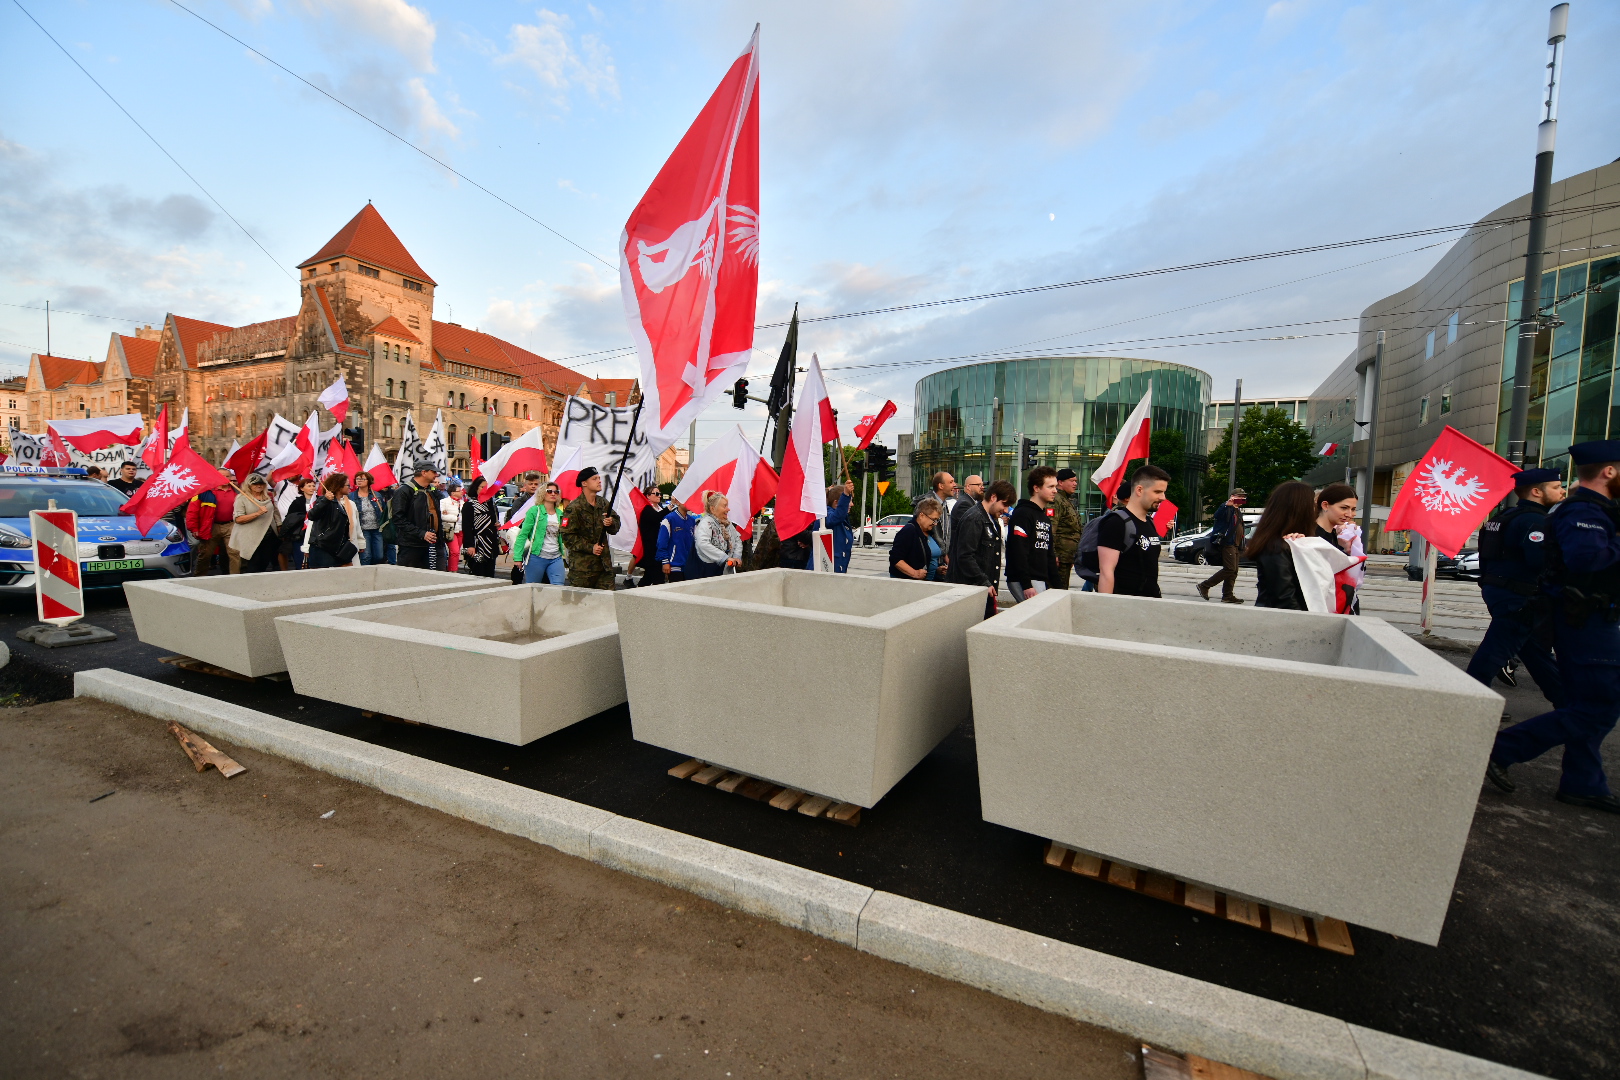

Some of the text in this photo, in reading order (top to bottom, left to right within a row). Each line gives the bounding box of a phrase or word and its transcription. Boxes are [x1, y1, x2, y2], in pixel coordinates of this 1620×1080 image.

[6, 465, 46, 474] POLICJA
[89, 560, 141, 571] HPU D516
